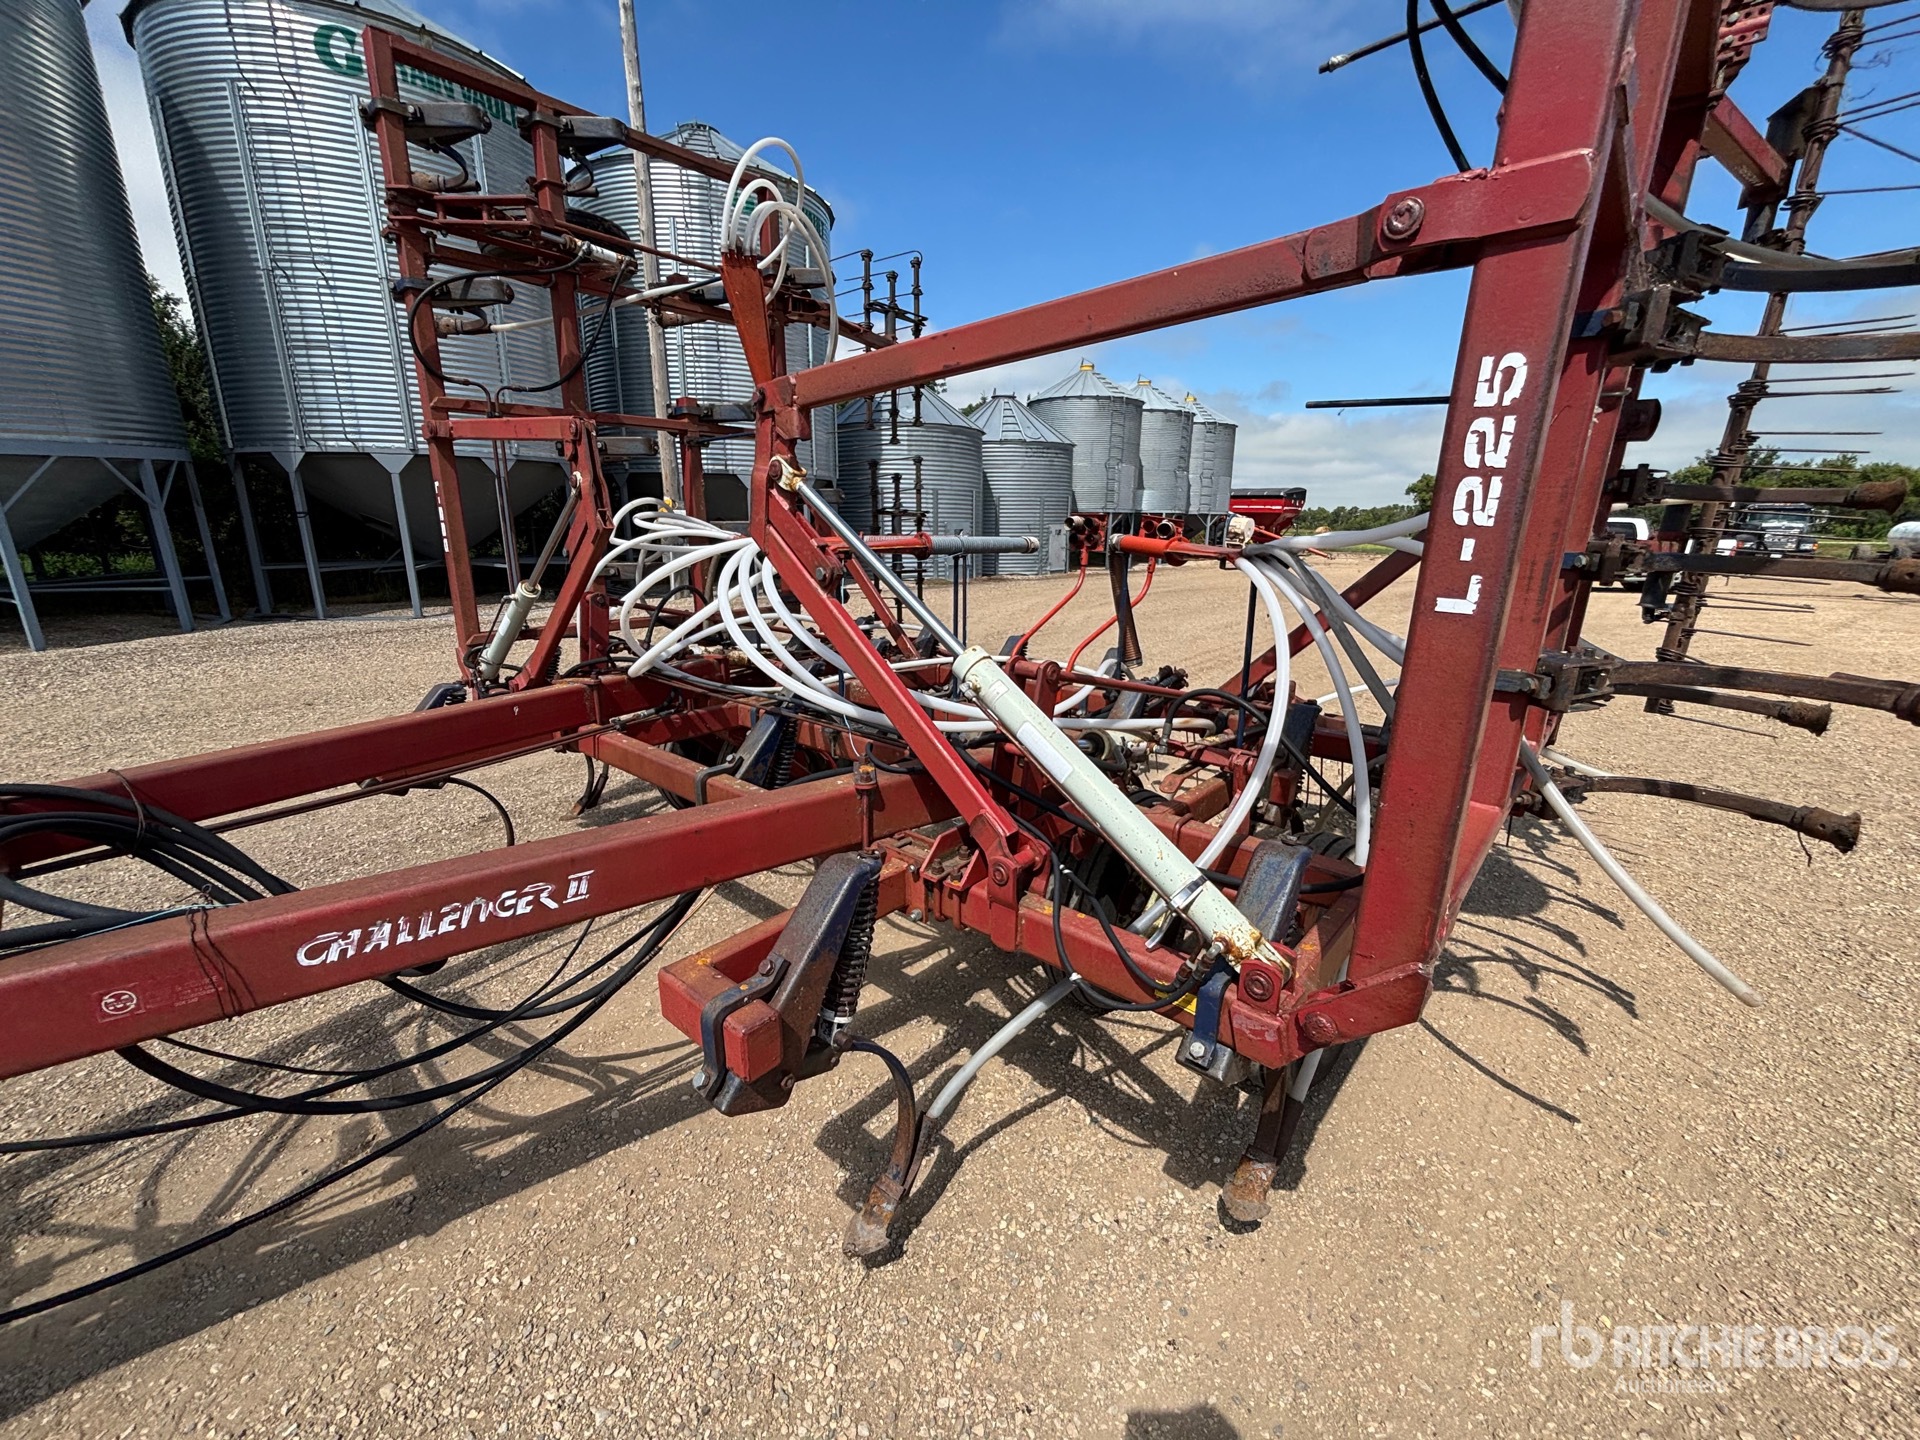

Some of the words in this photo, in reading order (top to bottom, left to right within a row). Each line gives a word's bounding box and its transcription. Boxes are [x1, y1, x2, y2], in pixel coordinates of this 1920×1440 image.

[1434, 352, 1528, 615] L-225
[296, 882, 559, 967] CHALLENGER
[563, 869, 595, 904] II
